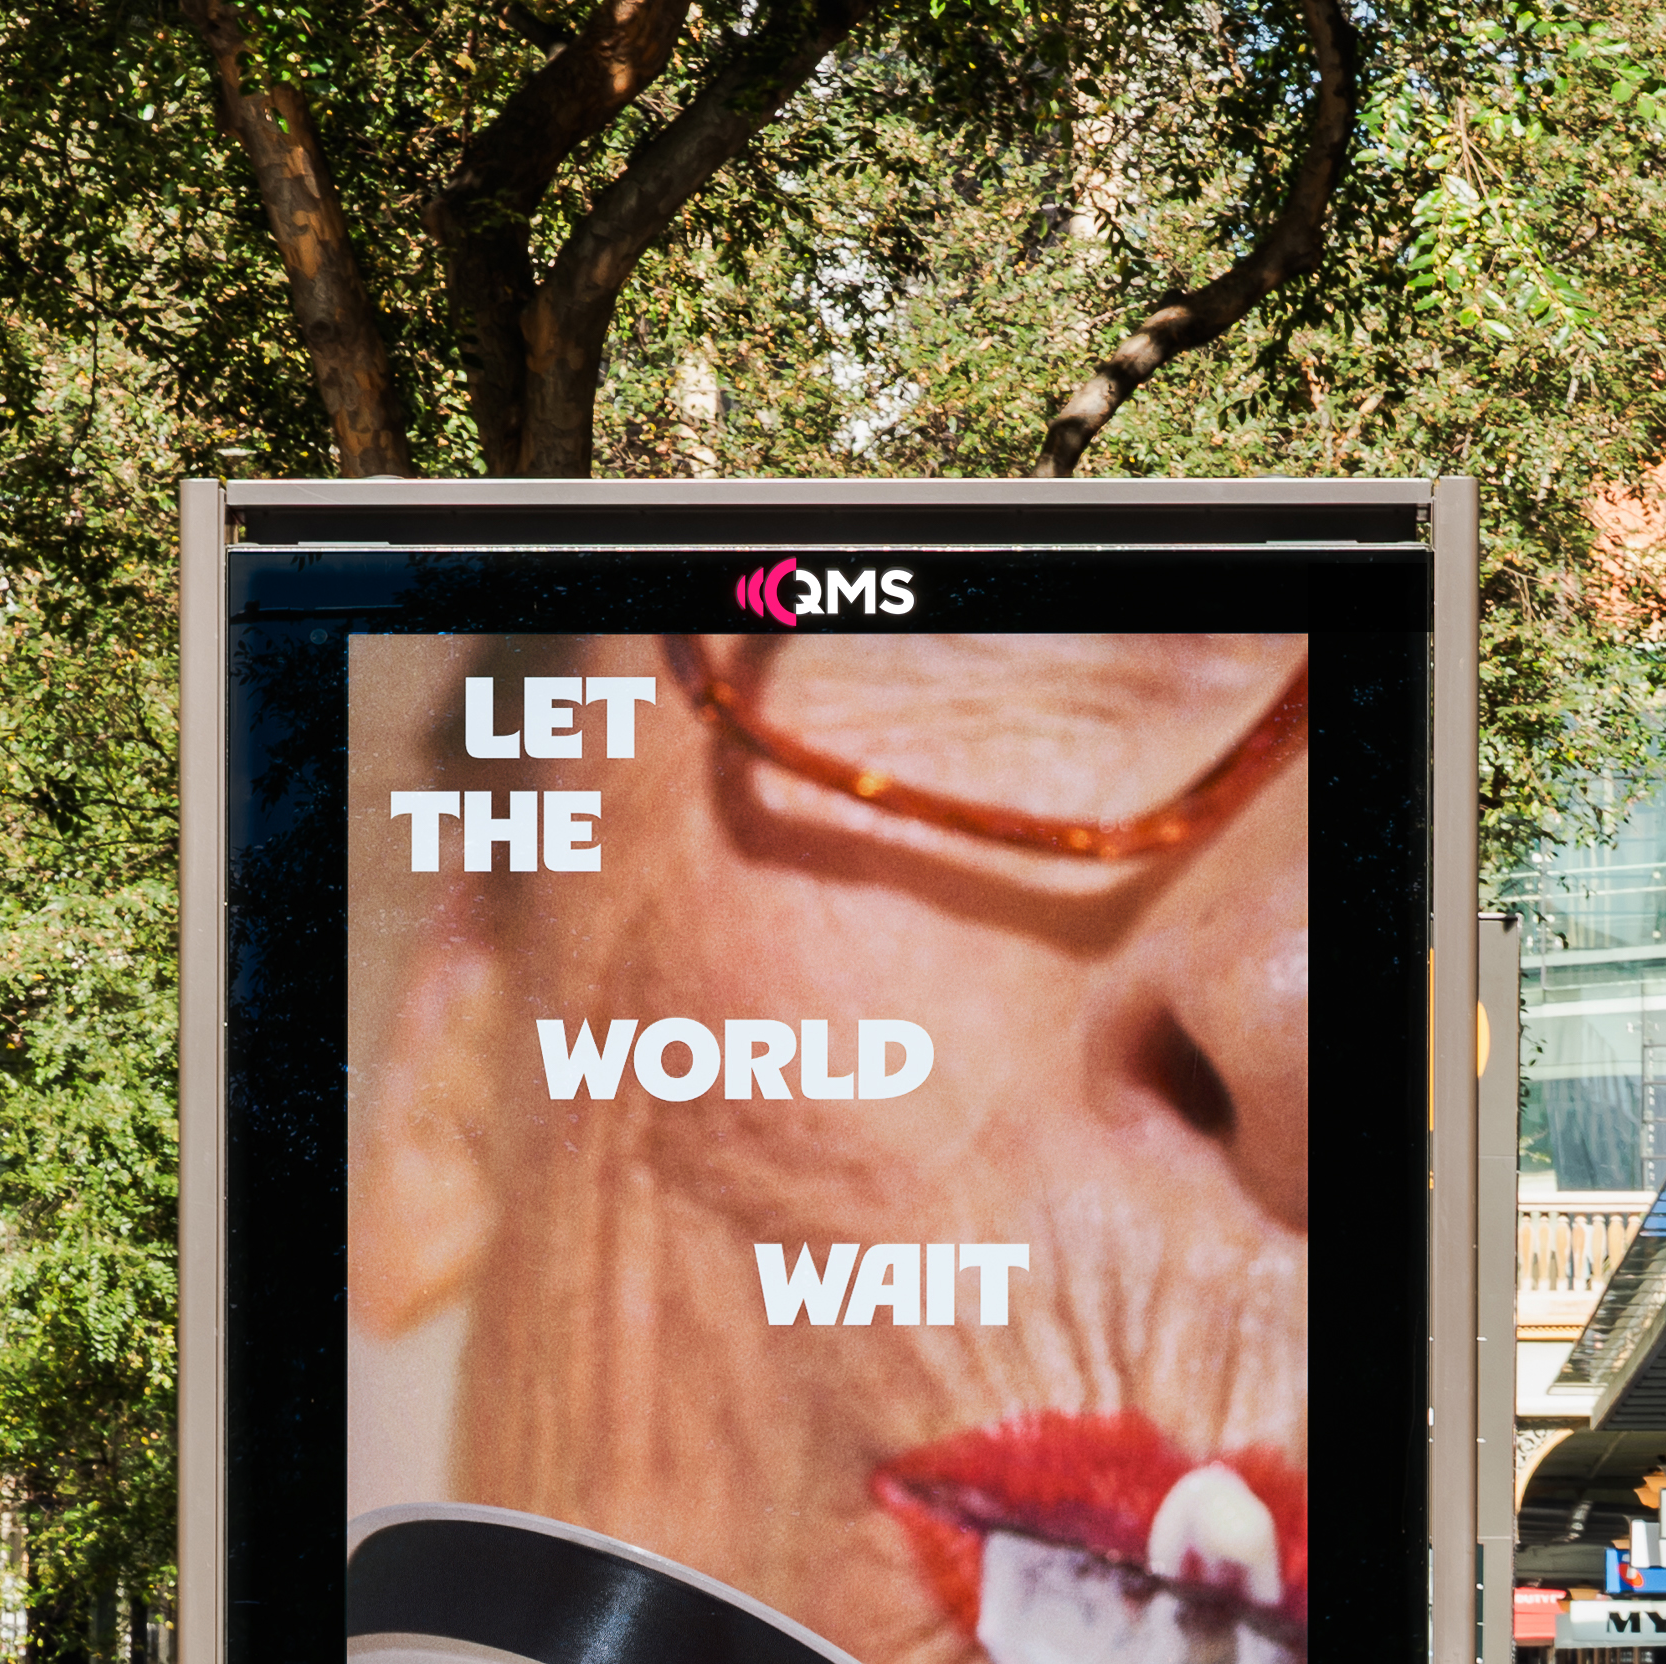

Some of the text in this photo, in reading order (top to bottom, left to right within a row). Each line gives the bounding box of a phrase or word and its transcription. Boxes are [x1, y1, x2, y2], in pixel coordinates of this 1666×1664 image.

[765, 560, 916, 622] QMS
[465, 676, 656, 759] LET
[390, 790, 602, 872] THE
[537, 1017, 934, 1102] WORLD
[754, 1243, 1030, 1326] WAIT
